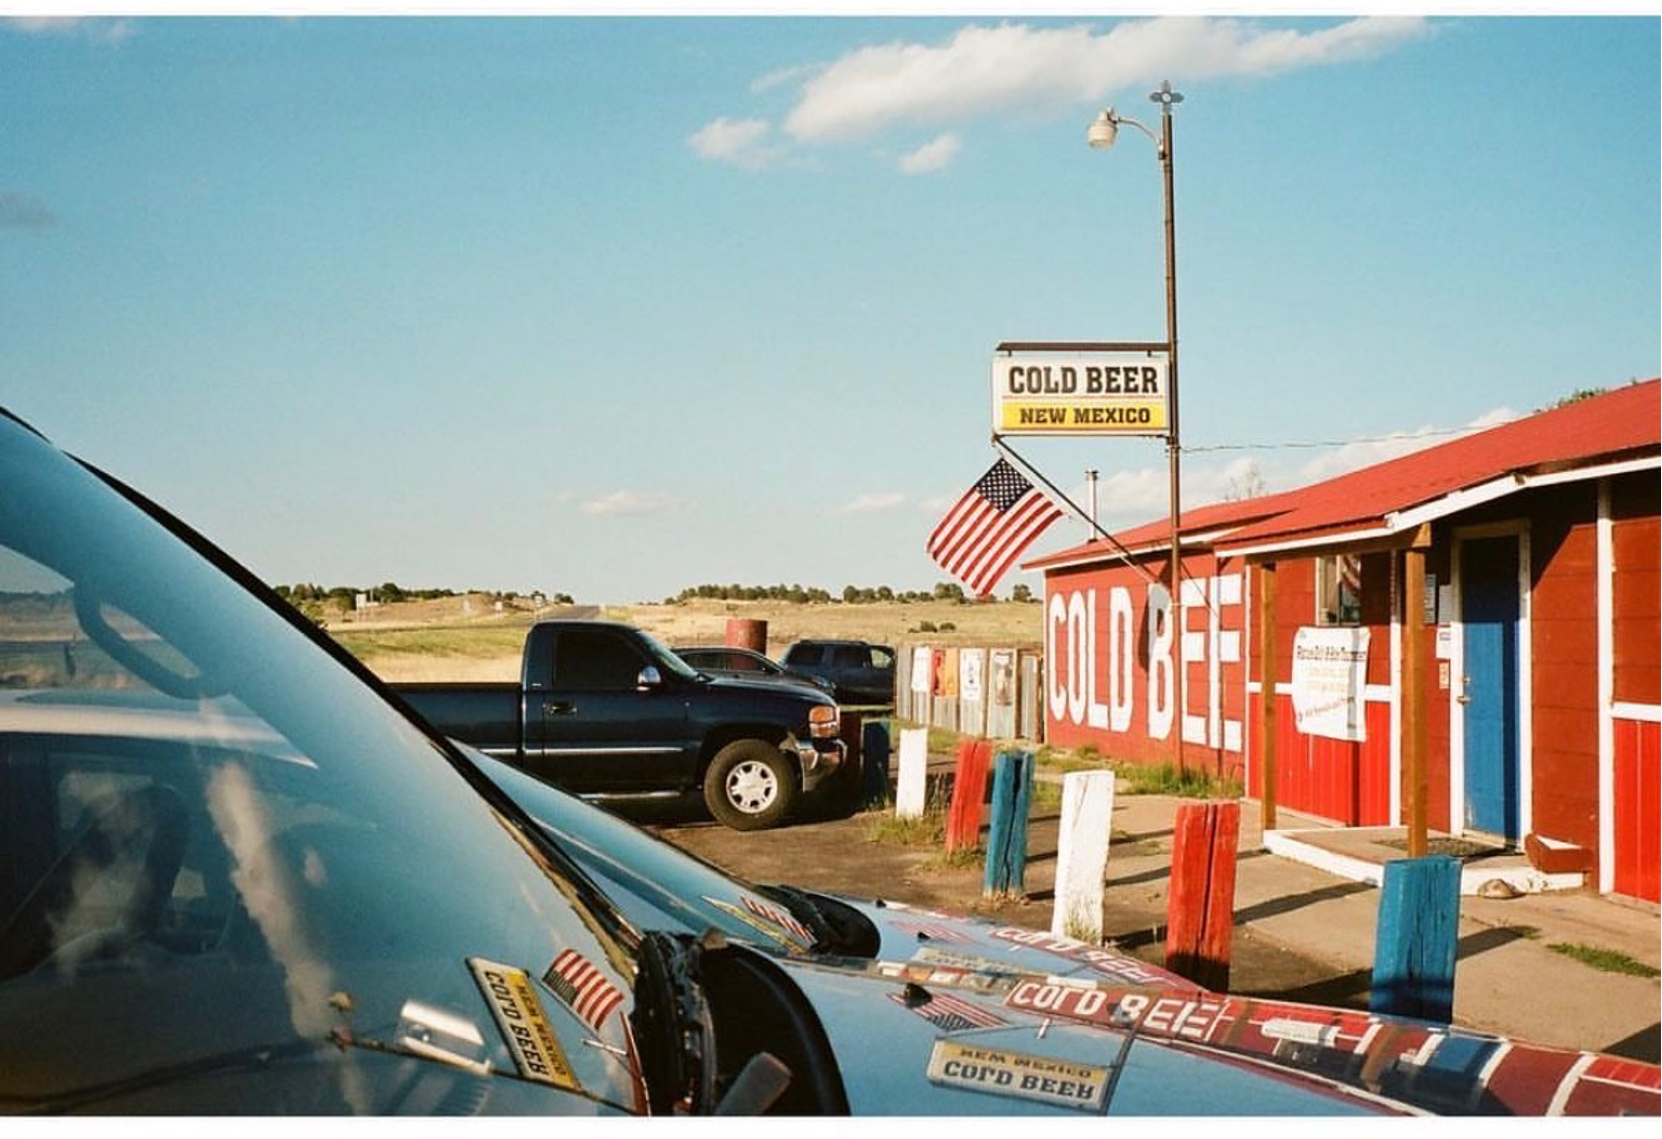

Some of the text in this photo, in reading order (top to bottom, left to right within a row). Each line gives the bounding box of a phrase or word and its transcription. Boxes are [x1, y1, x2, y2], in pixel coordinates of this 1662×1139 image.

[1009, 366, 1158, 394] COLD BEER
[1020, 407, 1151, 424] NEW MEXICO
[1049, 586, 1133, 733] COLD
